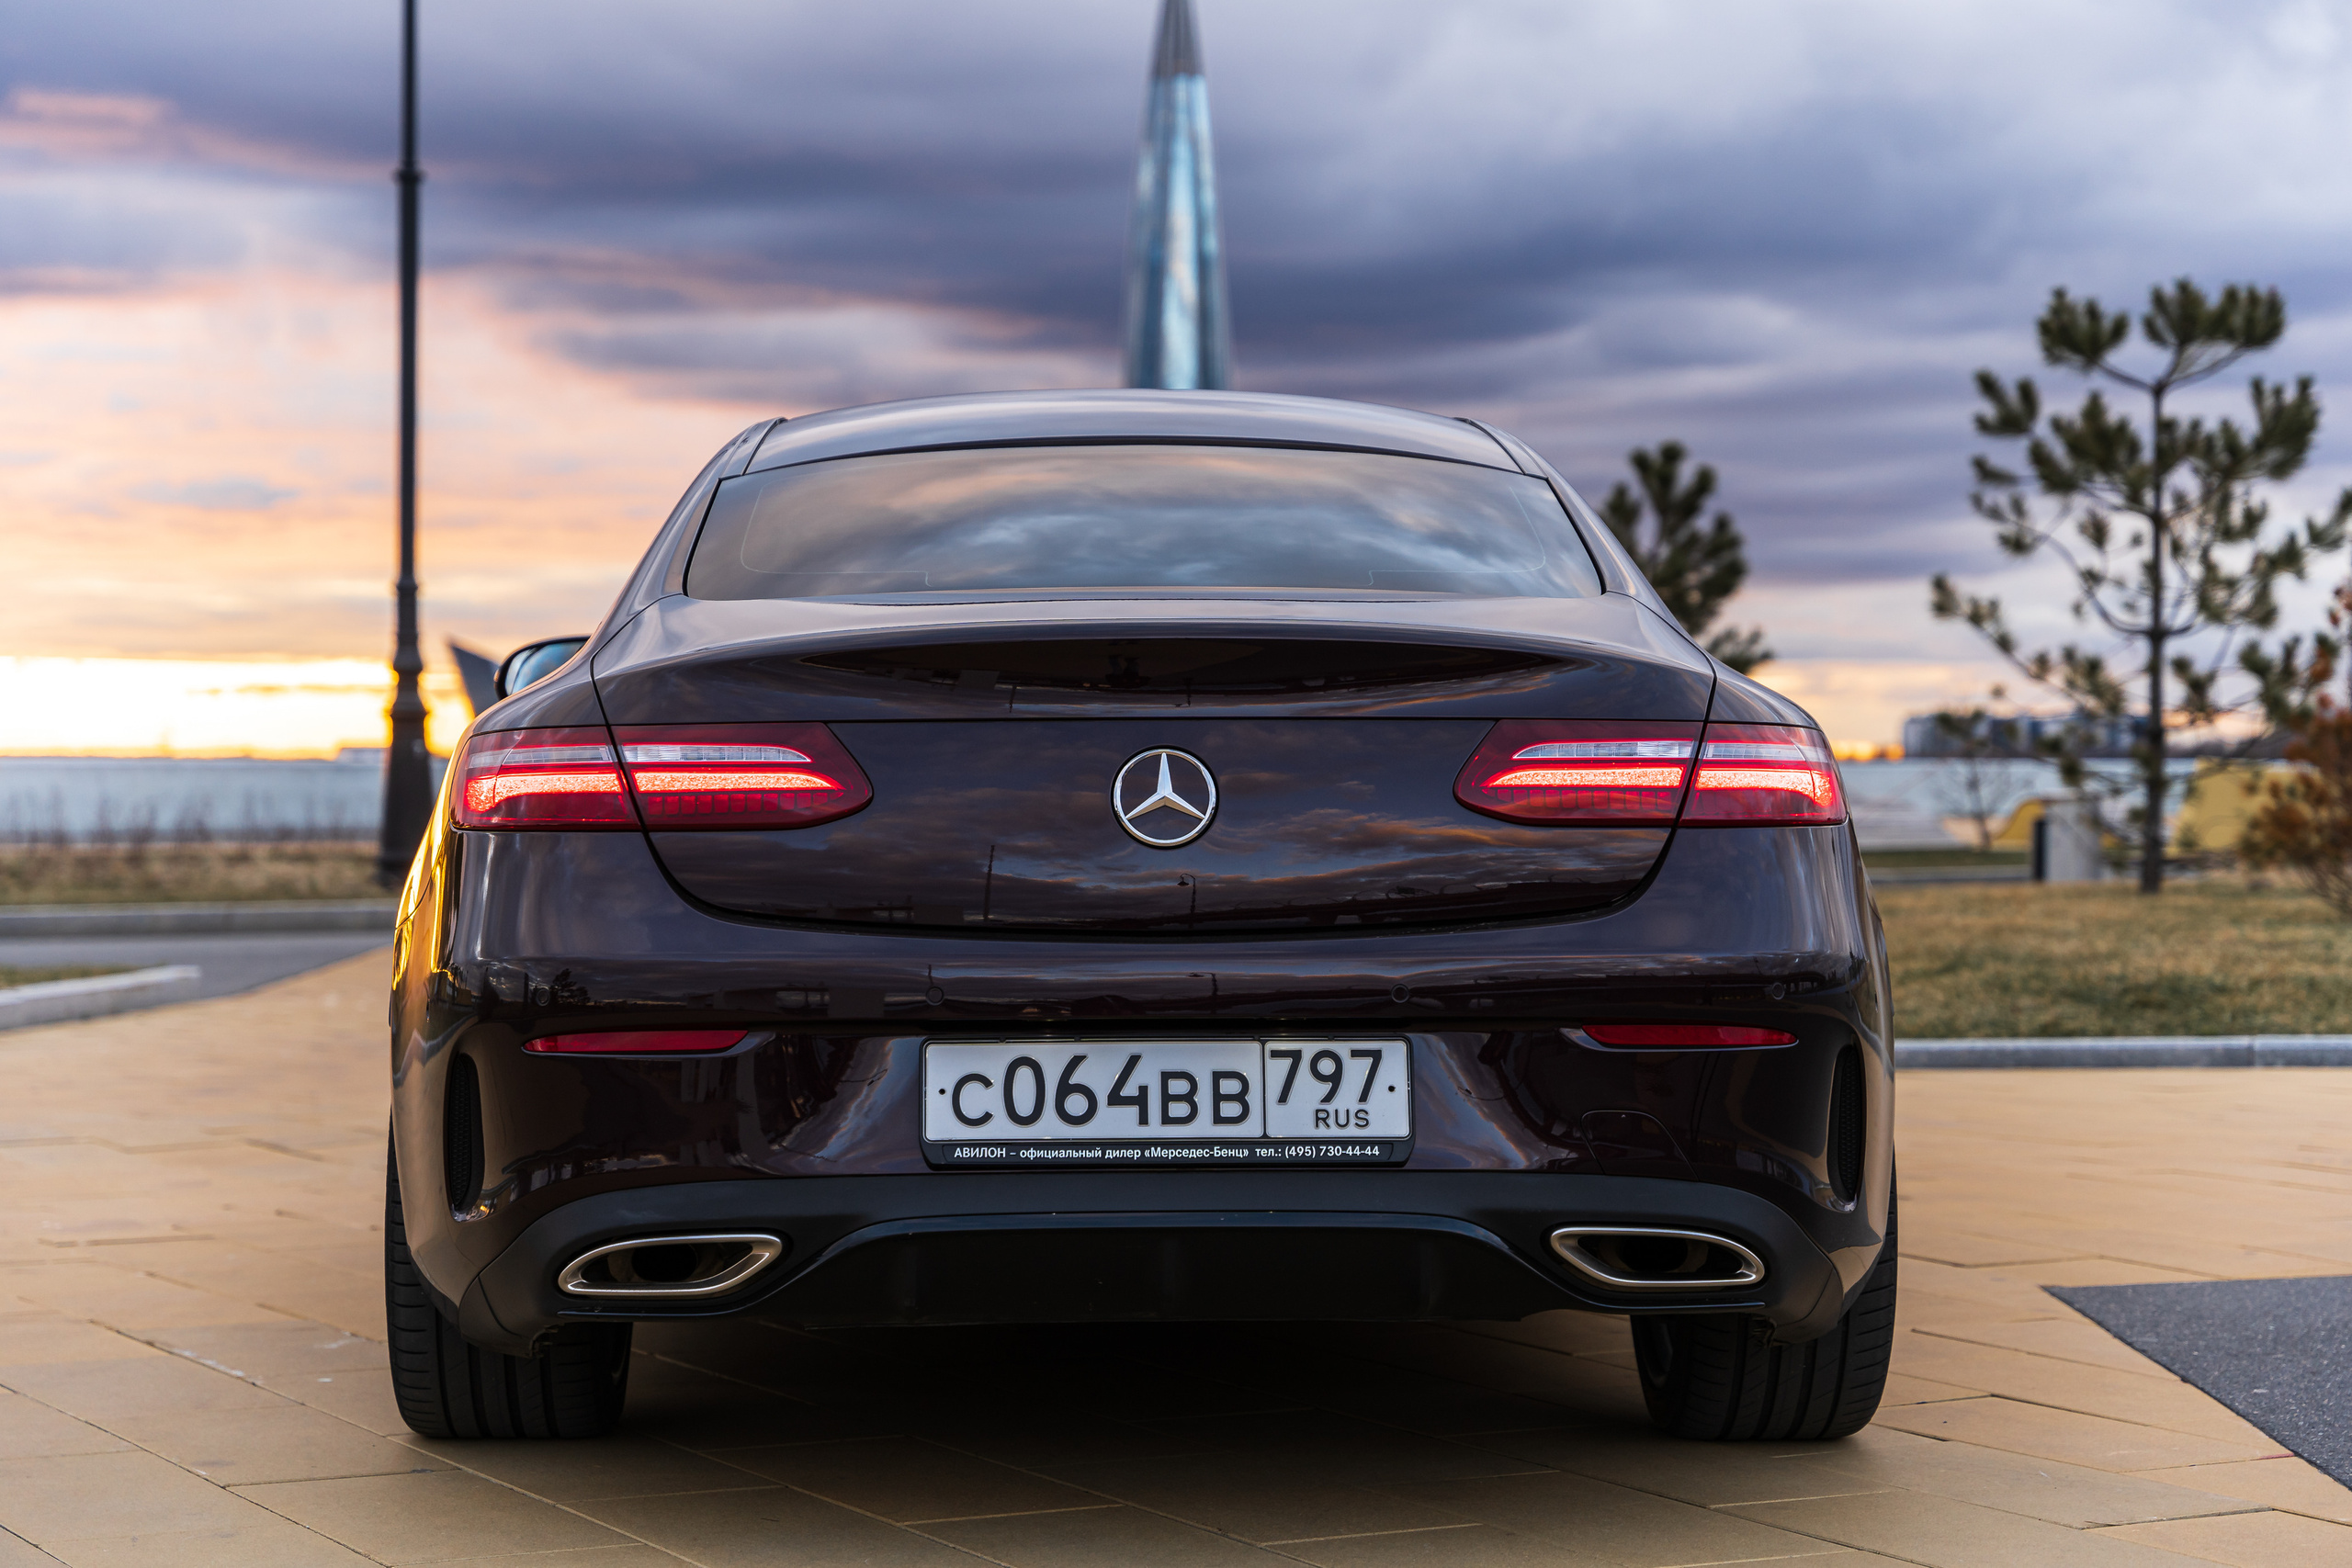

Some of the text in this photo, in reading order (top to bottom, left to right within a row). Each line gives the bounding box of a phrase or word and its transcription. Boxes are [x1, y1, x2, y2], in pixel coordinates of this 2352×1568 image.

[1270, 1049, 1384, 1104] 797
[1314, 1108, 1371, 1130] RUS
[954, 1146, 1006, 1158] АВИЛОН
[1019, 1146, 1102, 1160] официальный
[1104, 1149, 1141, 1160] дилер
[1144, 1145, 1250, 1160] «Мерседес-Бенц»
[1255, 1148, 1282, 1157] тел.:
[1284, 1145, 1316, 1159] (495)
[1319, 1145, 1380, 1156] 730-44-44
